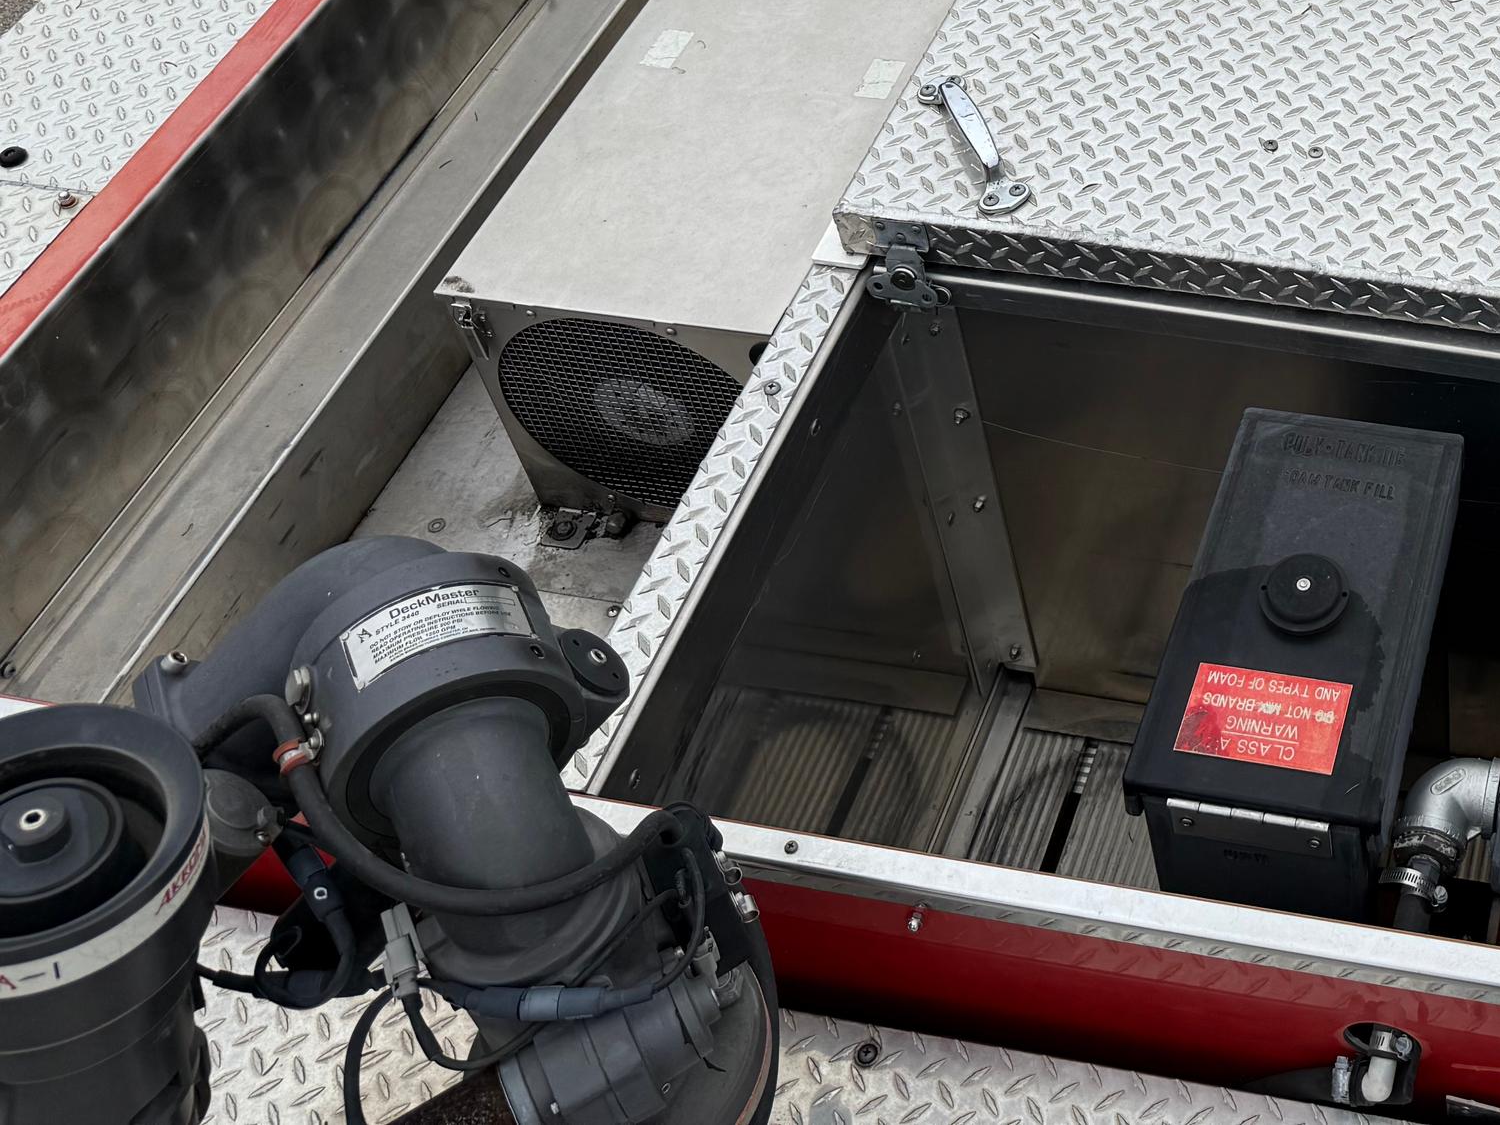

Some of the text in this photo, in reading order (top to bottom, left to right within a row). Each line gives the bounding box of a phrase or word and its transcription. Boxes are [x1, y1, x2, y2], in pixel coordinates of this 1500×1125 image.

[1363, 481, 1395, 501] FILL
[389, 589, 480, 619] DeckMaster
[436, 599, 464, 608] SERIAL
[369, 641, 379, 649] DO
[379, 633, 392, 642] NOT
[393, 623, 412, 635] STOW
[424, 611, 450, 622] DEPLOY
[371, 641, 388, 653] READ
[389, 623, 426, 644] OPERATING
[427, 611, 475, 626] INSTRUCTIONS
[375, 619, 400, 635] STYLE
[373, 638, 402, 659] MAXIMUM
[403, 625, 439, 641] PRESSURE
[374, 643, 404, 664] MAXIMUM
[405, 636, 423, 646] FLOW
[1207, 670, 1341, 702] AND TYPES OF FOAM
[1202, 691, 1256, 712] BRANDS
[1284, 706, 1312, 720] NOT
[1225, 715, 1299, 740] WARNING
[1219, 736, 1295, 761] CLASS A
